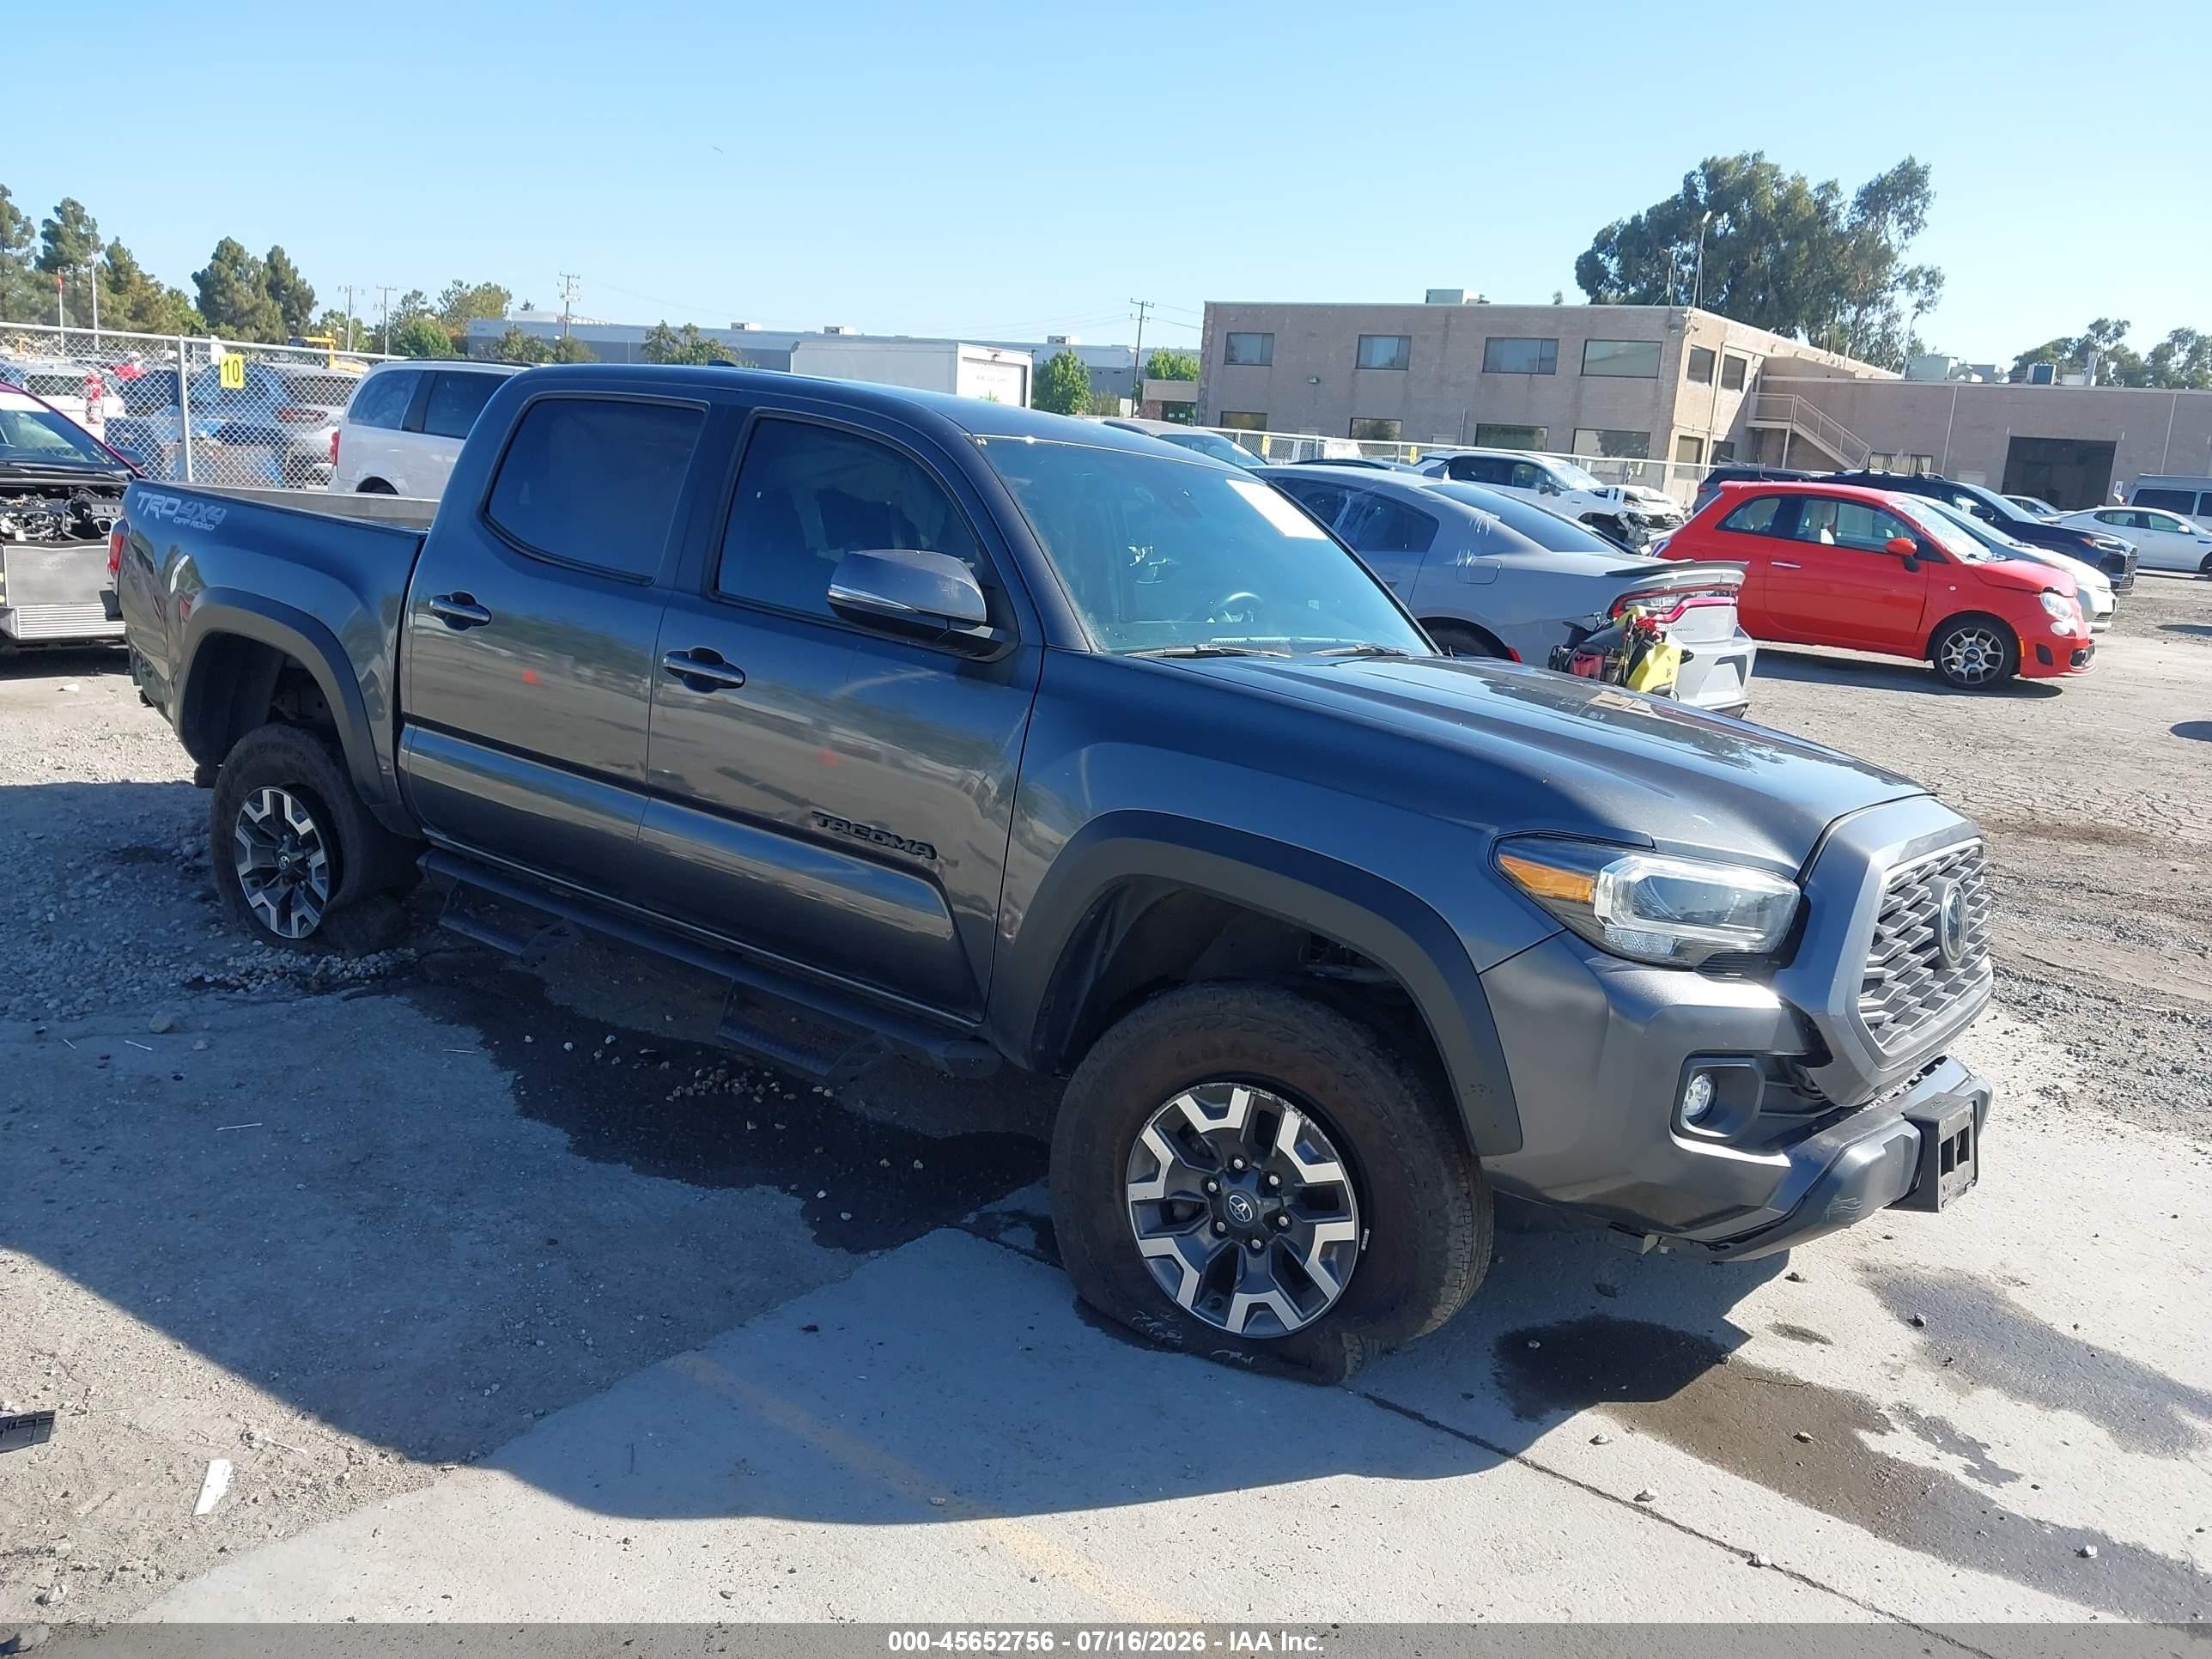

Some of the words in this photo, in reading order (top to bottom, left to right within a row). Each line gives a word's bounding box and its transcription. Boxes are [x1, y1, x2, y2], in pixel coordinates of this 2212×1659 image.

[223, 359, 240, 383] 10
[137, 491, 181, 520] TRD
[173, 516, 190, 526] OFF
[190, 520, 215, 531] ROAD
[811, 811, 937, 860] TACOMA
